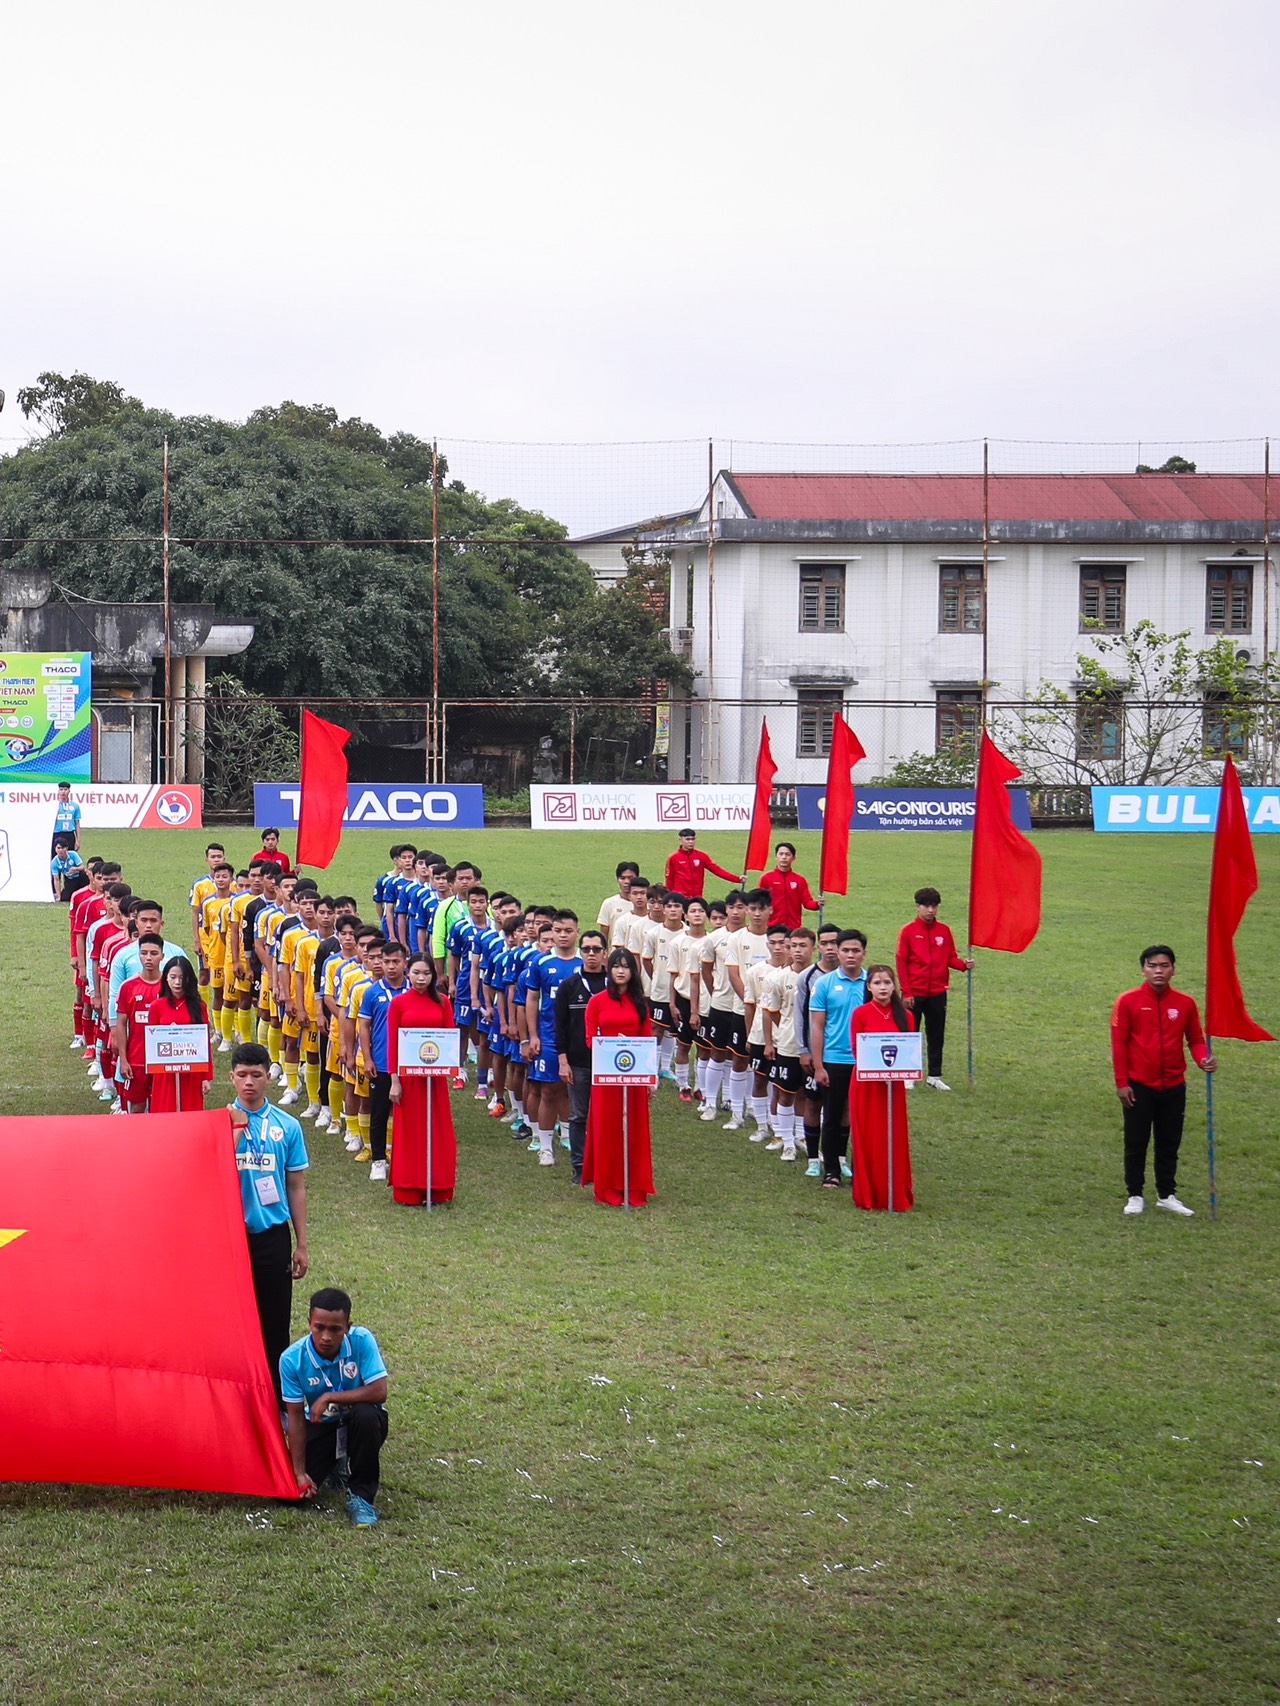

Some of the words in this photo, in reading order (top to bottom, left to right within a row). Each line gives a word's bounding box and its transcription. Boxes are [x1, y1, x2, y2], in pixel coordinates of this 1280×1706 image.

[9, 793, 40, 803] SINH
[76, 792, 103, 806] VIỆT
[106, 794, 138, 804] NAM
[280, 790, 458, 821] TACO
[583, 808, 608, 820] DUY
[610, 805, 636, 820] TÂN
[696, 808, 721, 820] DUY
[724, 805, 750, 820] TÂN
[857, 801, 976, 815] SAIGONTOURIS
[879, 817, 892, 826] Tận
[893, 817, 917, 826] hưởng
[919, 817, 933, 825] bản
[935, 817, 947, 825] sắc
[948, 818, 962, 826] Việt
[460, 1005, 469, 1017] 17
[654, 1008, 663, 1020] 10
[308, 1031, 317, 1042] 18
[779, 1066, 788, 1080] 14
